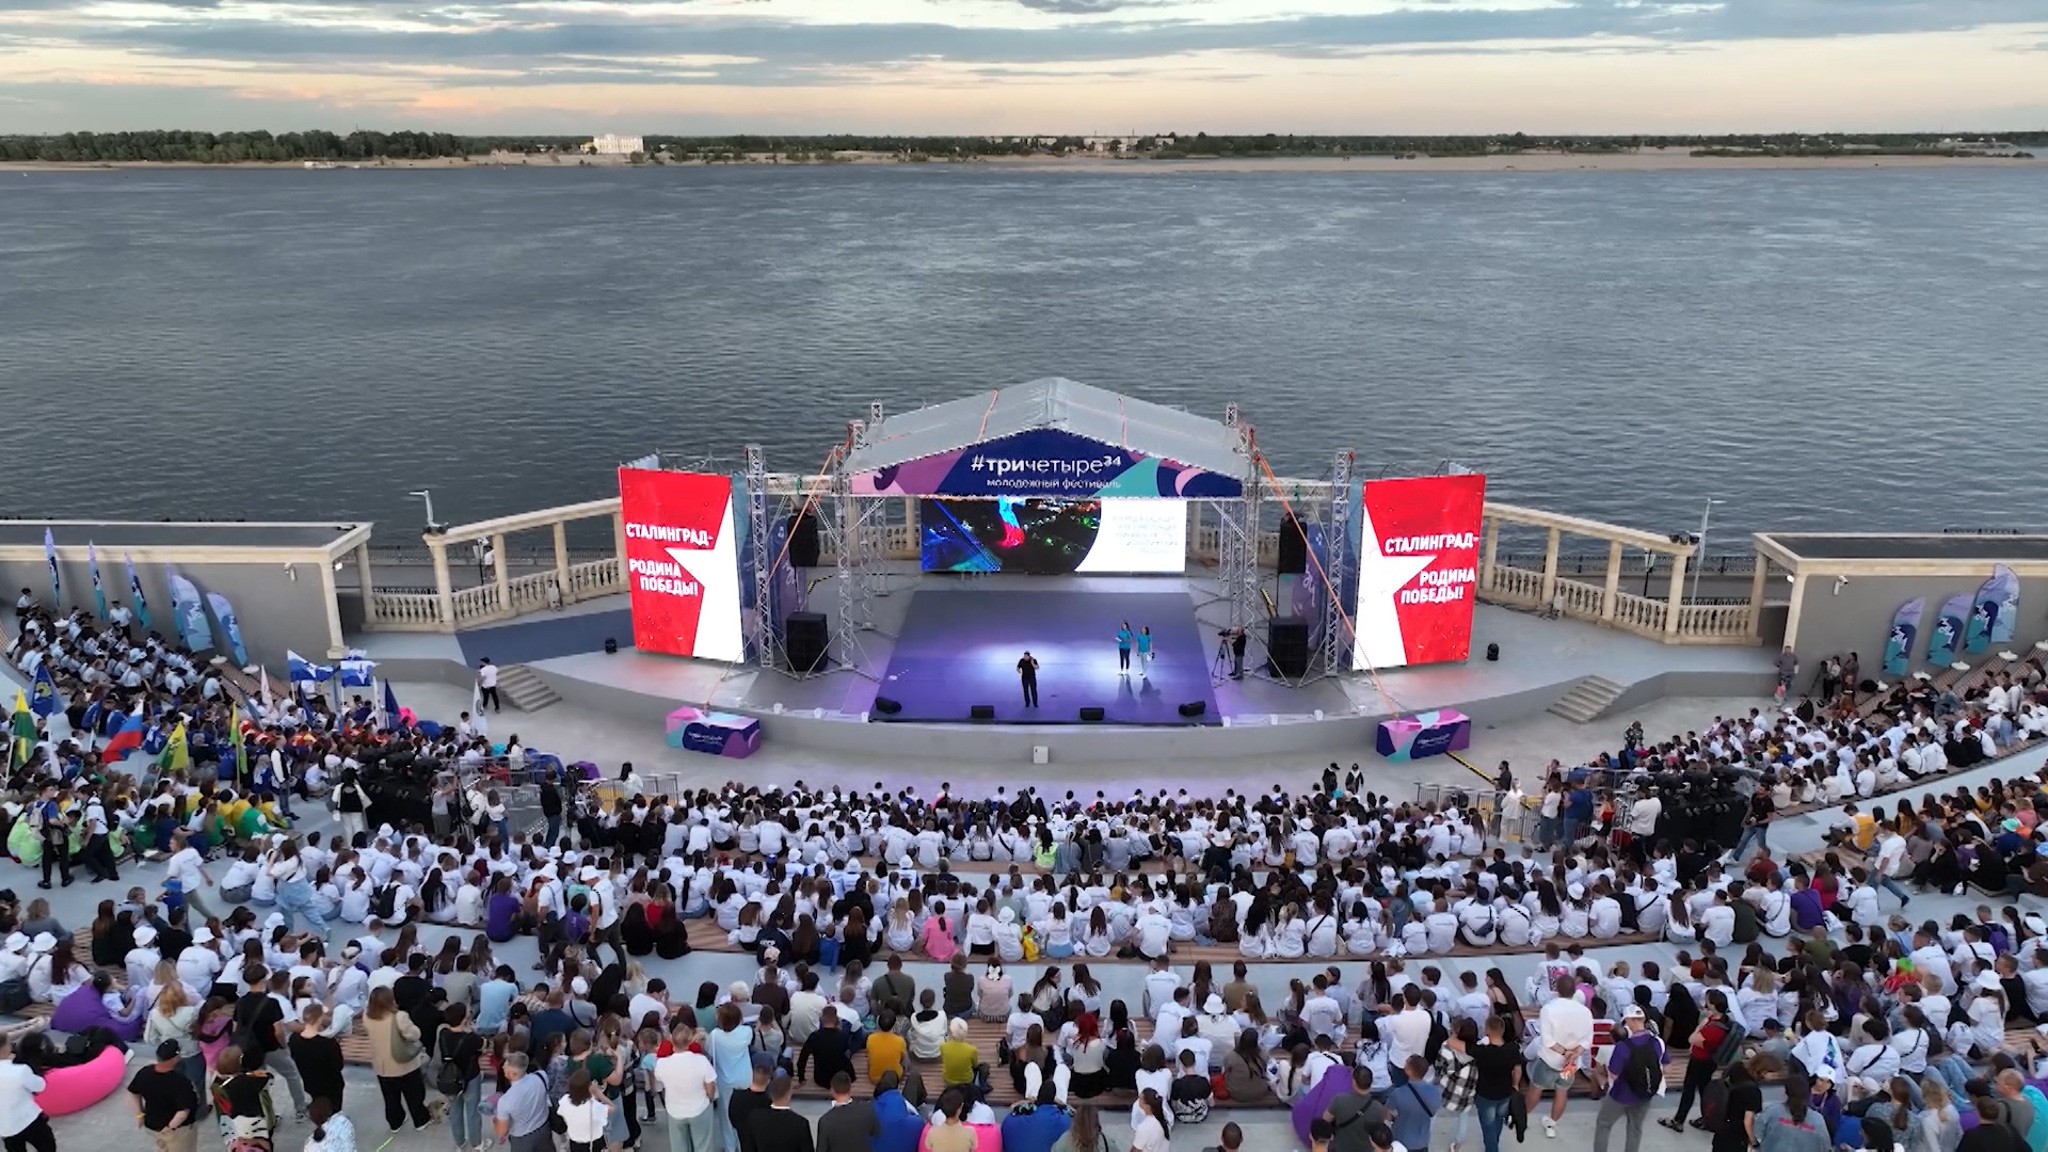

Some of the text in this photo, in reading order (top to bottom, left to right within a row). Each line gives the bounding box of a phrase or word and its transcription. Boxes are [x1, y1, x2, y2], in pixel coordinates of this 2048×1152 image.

[1062, 477, 1122, 490] фестиваль
[625, 522, 714, 546] СТАЛИНГРАД-
[1384, 532, 1480, 554] СТАЛИНГРАД-
[629, 558, 682, 578] РОДИНА
[1419, 567, 1476, 587] РОДИНА
[640, 575, 699, 597] ПОБЕДЫ!
[1400, 585, 1464, 604] ПОБЕДЫ!
